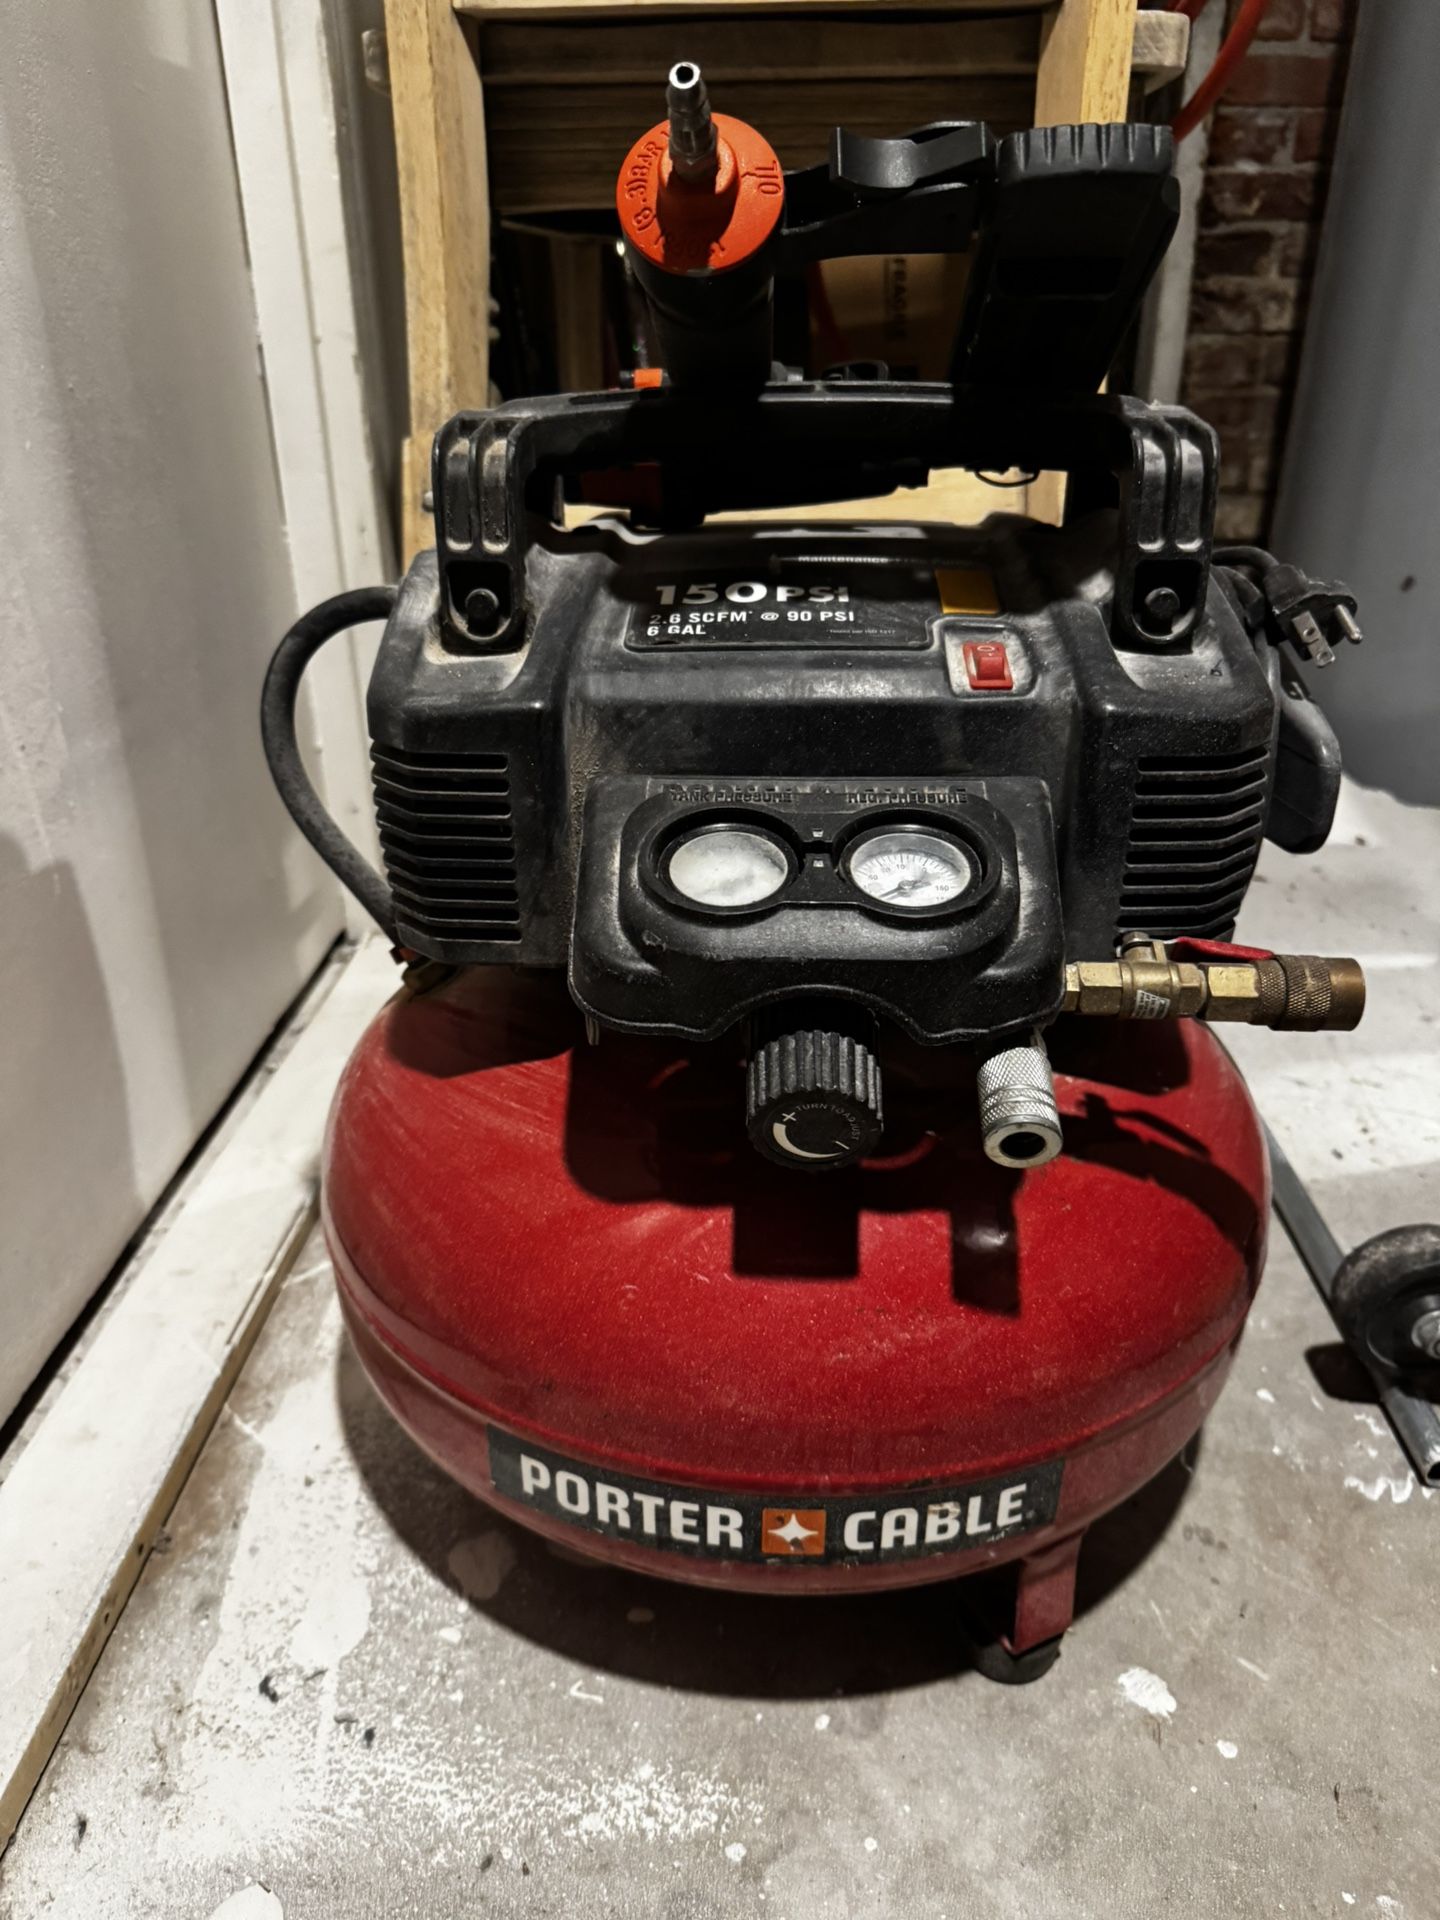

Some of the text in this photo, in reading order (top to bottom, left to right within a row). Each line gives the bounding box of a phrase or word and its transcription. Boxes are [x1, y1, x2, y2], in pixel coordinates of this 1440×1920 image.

[656, 582, 850, 605] 150 PSI
[650, 611, 681, 625] 2.6
[760, 612, 779, 621] @
[787, 610, 812, 622] 90
[819, 610, 854, 622] PSI
[647, 624, 707, 636] 6 GAL
[671, 790, 792, 803] TANK PRESSURE
[886, 792, 967, 804] PRESSURE
[796, 1103, 860, 1140] TURN TO ADJUST
[519, 1453, 1028, 1551] PORTER CABLE
